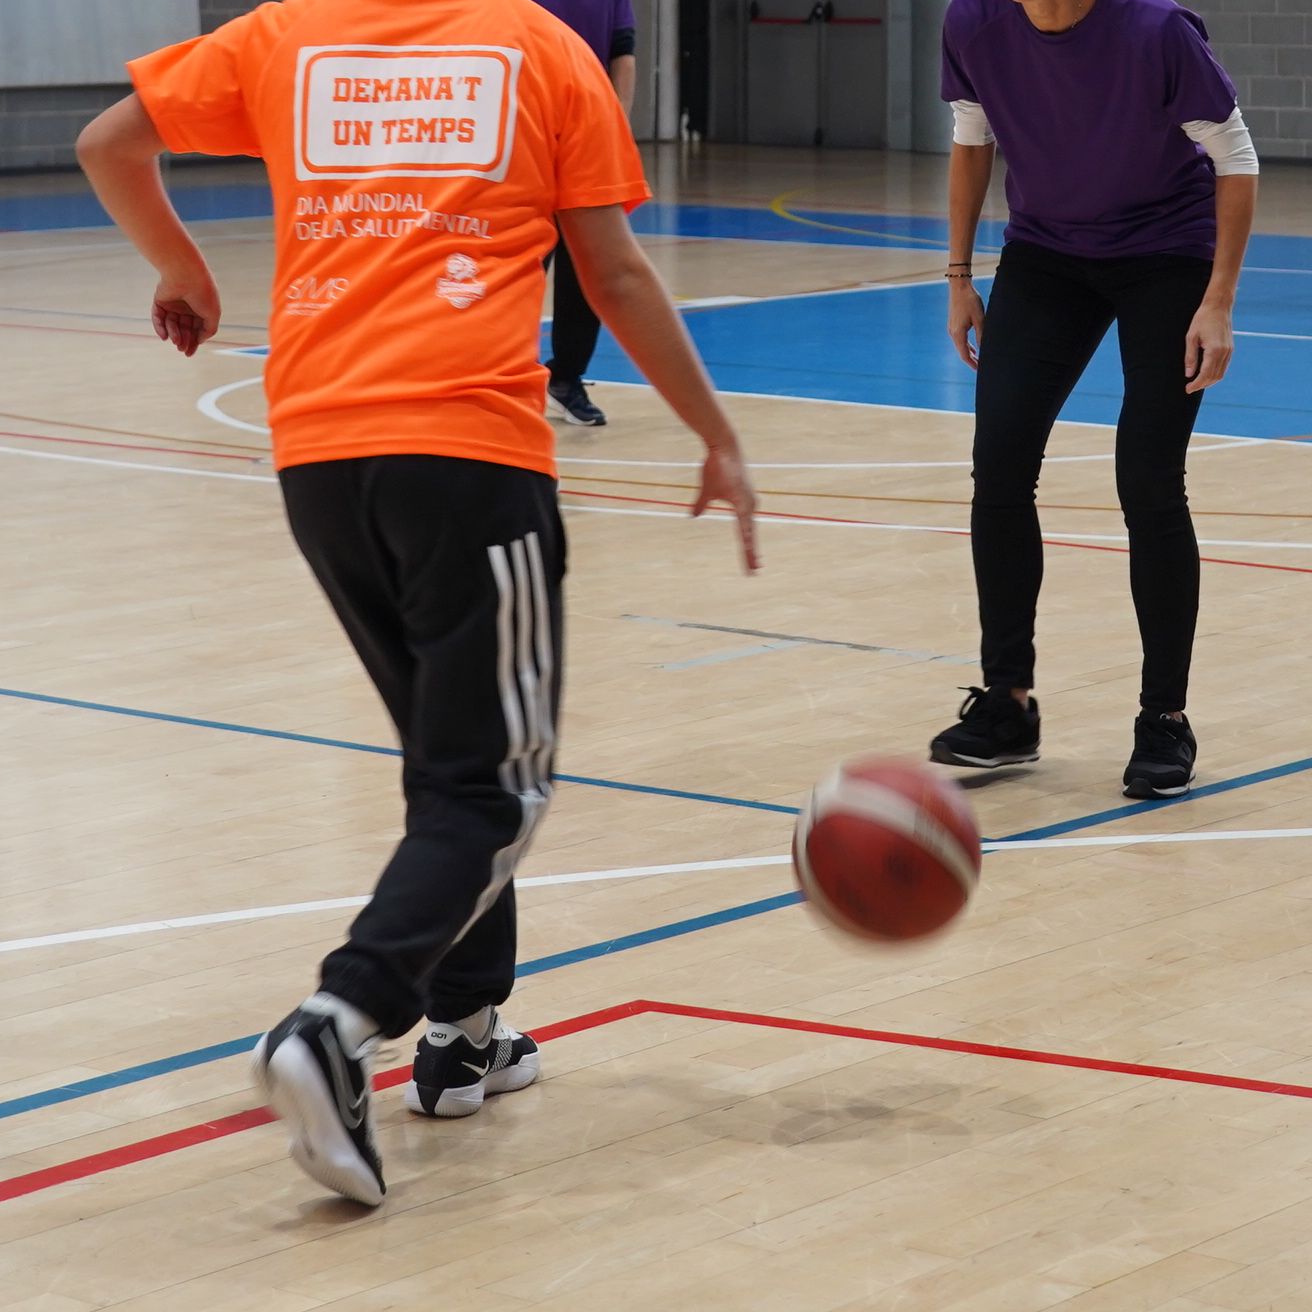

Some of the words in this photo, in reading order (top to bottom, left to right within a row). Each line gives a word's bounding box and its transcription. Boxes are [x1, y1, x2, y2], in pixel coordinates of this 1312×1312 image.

[333, 120, 373, 146] UN
[381, 117, 476, 145] TEMPS
[296, 196, 329, 215] DIA
[331, 193, 429, 213] MUNDIAL
[350, 218, 417, 238] SALUT
